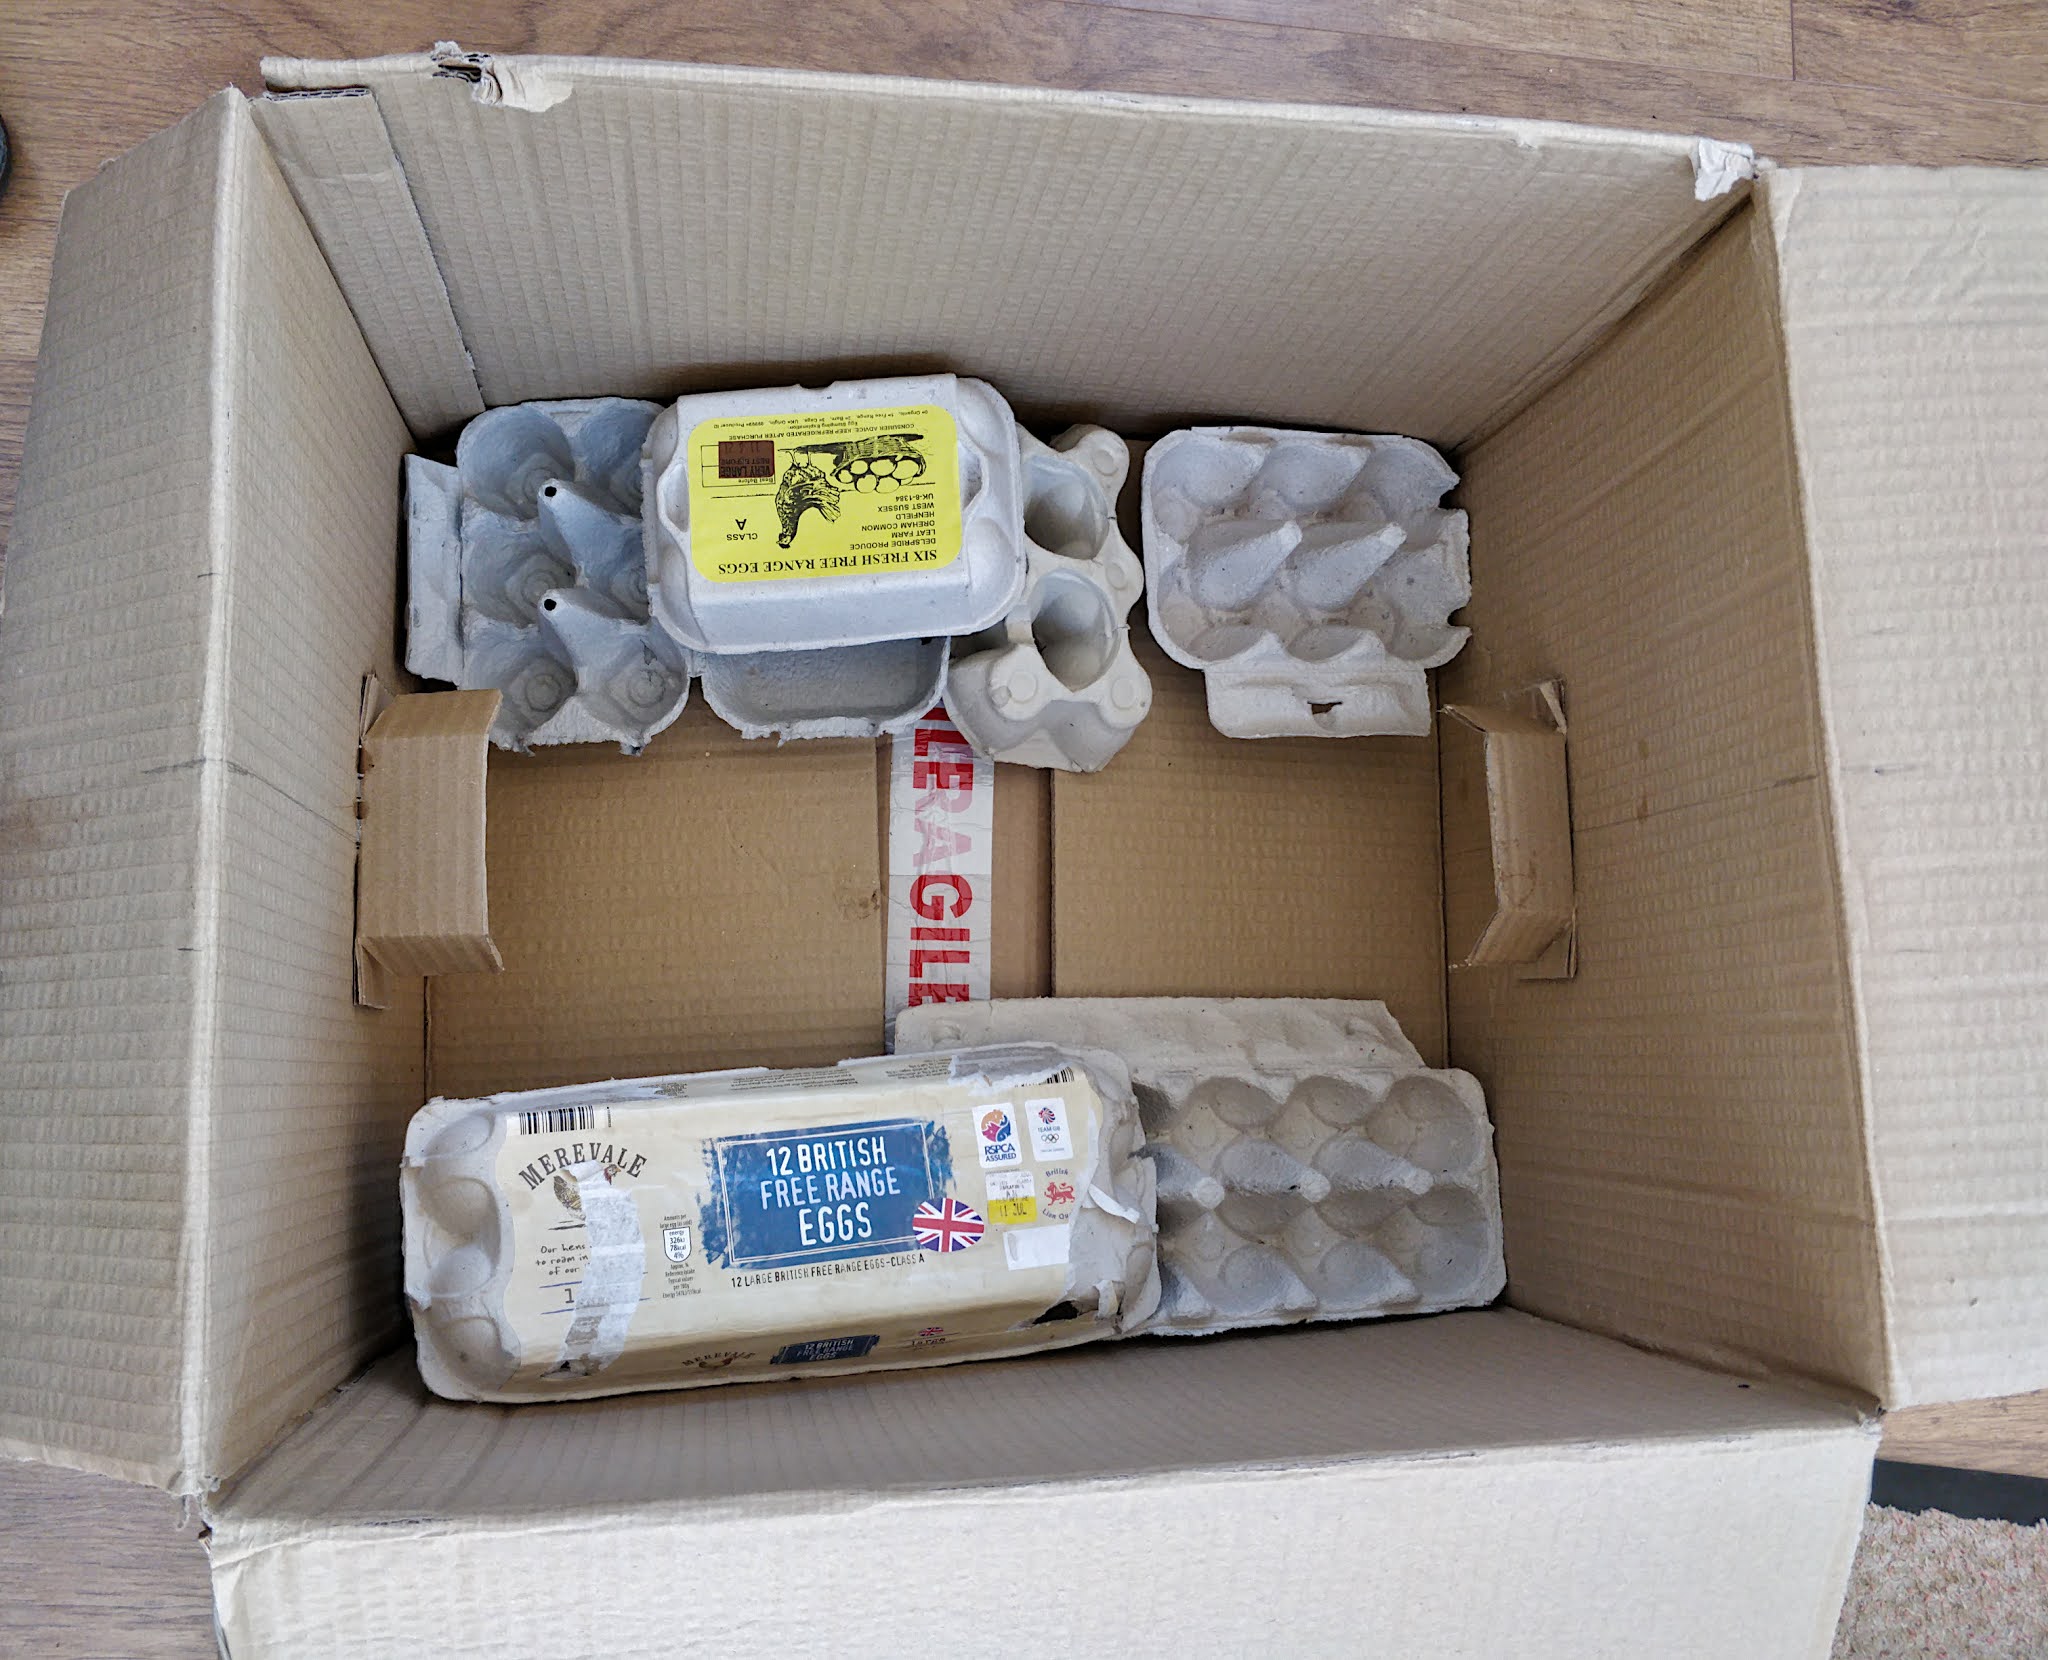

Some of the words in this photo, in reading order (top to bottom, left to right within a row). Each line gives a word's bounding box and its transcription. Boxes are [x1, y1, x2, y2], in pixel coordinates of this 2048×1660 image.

[720, 466, 748, 477] LARGE
[750, 466, 770, 477] VERY
[896, 493, 934, 502] UK-8-1384
[878, 504, 909, 512] SUSSEX
[912, 502, 935, 510] WEST
[896, 511, 935, 520] HENFIELD
[735, 518, 747, 530] A
[862, 523, 898, 531] COMMON
[900, 520, 935, 529] OREHAM
[726, 533, 758, 541] CLASS
[850, 542, 889, 550] PRODUCE
[891, 538, 936, 547] DELSPRIDE
[862, 551, 909, 566] FRESH
[914, 550, 937, 562] SIX
[763, 559, 815, 572] RANGE
[820, 556, 857, 569] FREE
[718, 562, 758, 574] EGGS
[984, 1143, 1015, 1156] RSPCA
[766, 1146, 794, 1177] 12
[797, 1136, 887, 1174] BRITISH
[985, 1153, 1017, 1162] ASSURED
[518, 1142, 648, 1190] MEREVALE
[1046, 1168, 1068, 1177] British
[760, 1175, 821, 1210] FREE
[826, 1166, 900, 1202] RANGE
[798, 1202, 872, 1246] EGGS
[540, 1245, 557, 1254] Our
[550, 1256, 576, 1265] roam
[548, 1267, 561, 1276] of
[565, 1266, 580, 1274] our
[732, 1276, 742, 1288] 12
[744, 1271, 773, 1287] LARGE
[775, 1267, 809, 1282] BRITISH
[811, 1263, 833, 1278] FREE
[835, 1260, 862, 1275] RANGE
[864, 1255, 917, 1271] EGGS-CLASS
[918, 1253, 925, 1263] A
[815, 1338, 854, 1348] BRITISH
[809, 1352, 837, 1361] EGGS
